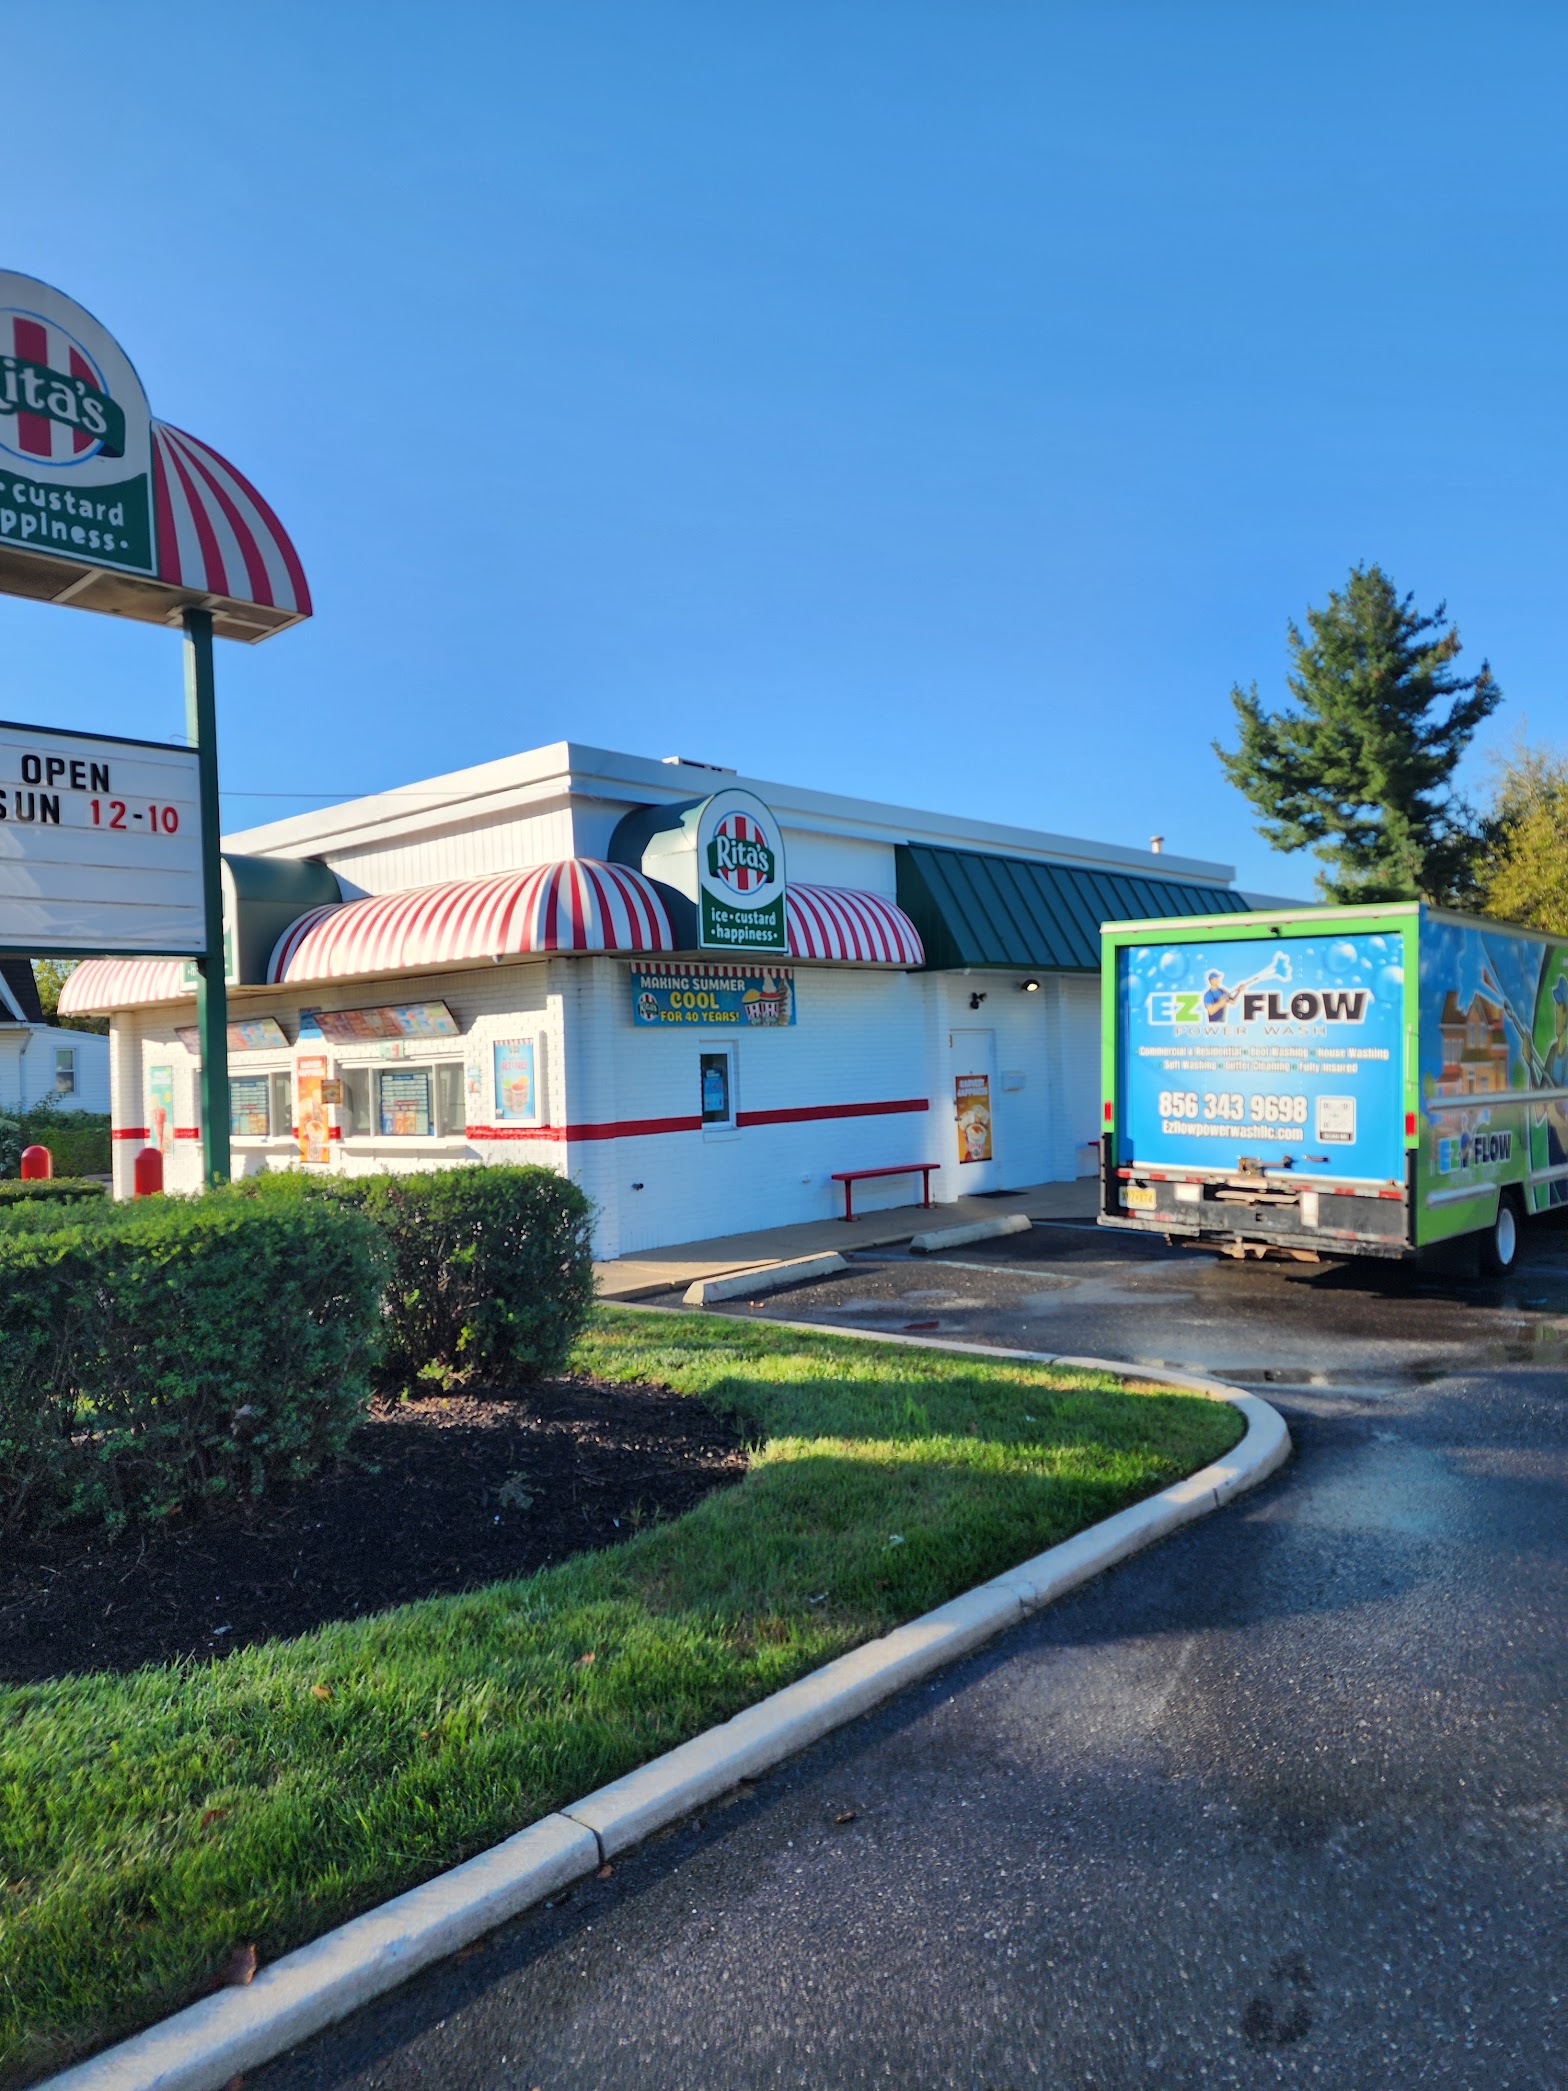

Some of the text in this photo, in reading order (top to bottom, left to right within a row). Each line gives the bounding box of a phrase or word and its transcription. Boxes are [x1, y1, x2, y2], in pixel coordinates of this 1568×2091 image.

[0, 359, 108, 434] ita's
[12, 482, 125, 526] custard
[21, 754, 110, 793] OPEN
[90, 799, 179, 834] 12-10
[716, 835, 769, 872] Rita's
[711, 907, 776, 925] ice custard
[716, 924, 773, 943] happiness
[640, 976, 745, 992] MAKING SUMMER
[669, 991, 720, 1010] COOL
[1150, 991, 1368, 1023] EZ FLOW
[660, 1011, 682, 1022] FOR
[685, 1011, 699, 1022] 40
[702, 1012, 740, 1023] YEARS!
[1175, 1026, 1326, 1036] POWER WASH
[1182, 1060, 1217, 1071] Washing
[1271, 1046, 1309, 1059] Washing
[1347, 1047, 1390, 1060] Washing
[1159, 1091, 1308, 1123] 856 343 9698
[1474, 1132, 1512, 1164] FLOW
